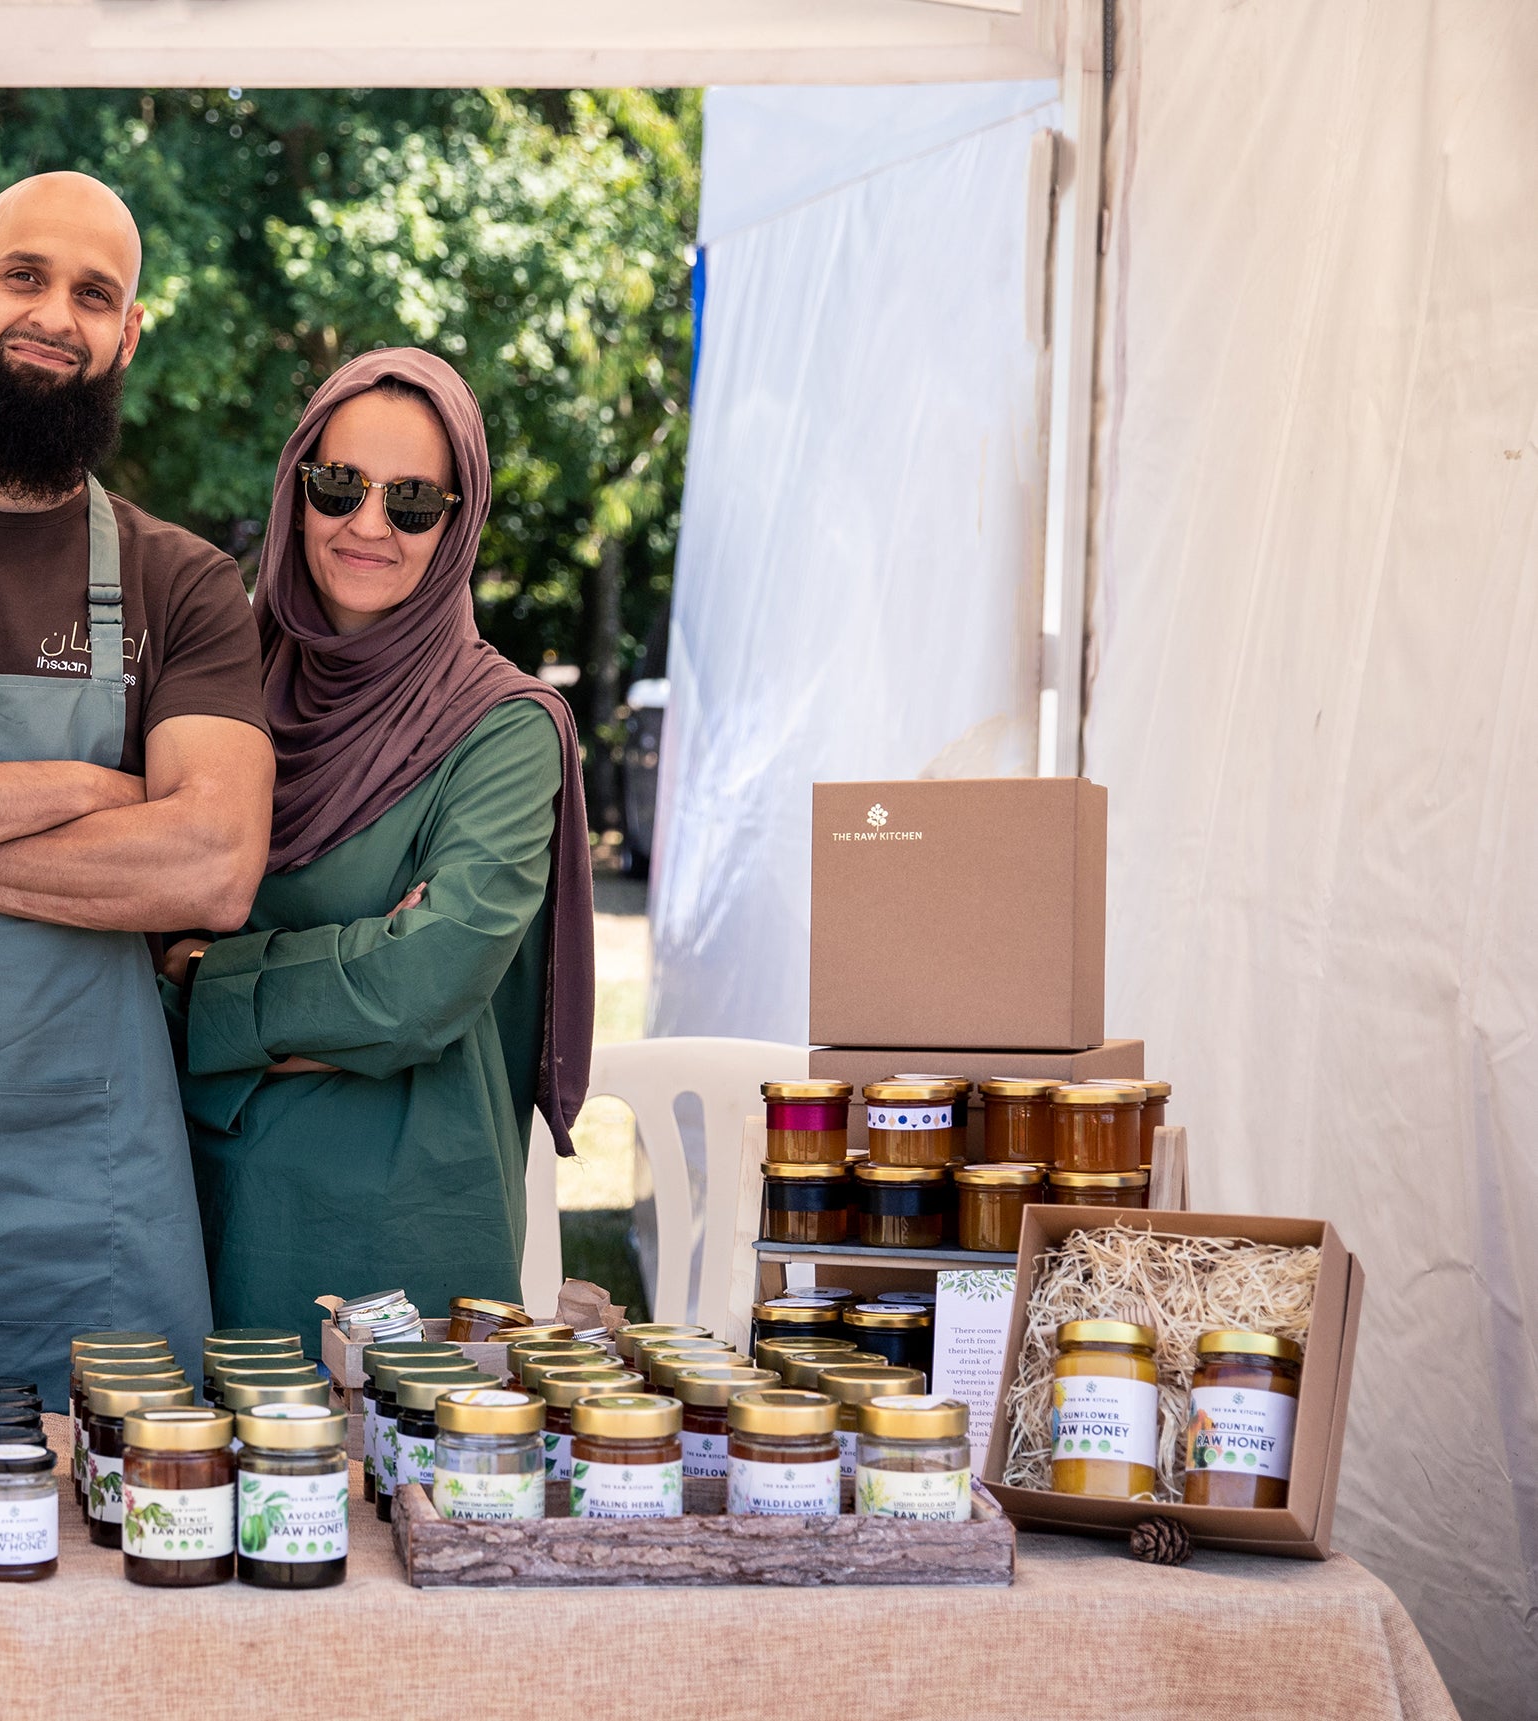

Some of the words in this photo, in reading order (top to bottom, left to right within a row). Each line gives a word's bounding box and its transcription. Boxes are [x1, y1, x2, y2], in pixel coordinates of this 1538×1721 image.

[36, 656, 88, 674] Ihsaan
[832, 832, 852, 842] THE
[854, 832, 878, 842] RAW
[879, 831, 923, 841] KITCHEN
[969, 1347, 997, 1356] bellies,
[946, 1369, 977, 1377] varying
[953, 1378, 987, 1386] wherein
[952, 1388, 982, 1397] healing
[983, 1388, 995, 1396] for
[1063, 1411, 1120, 1420] SUNFLOWER
[1057, 1424, 1079, 1436] RAW
[1081, 1424, 1130, 1438] HONEY
[1211, 1421, 1265, 1433] MOUNTAIN
[1196, 1434, 1223, 1447] RAW
[1226, 1436, 1277, 1452] HONEY
[589, 1498, 628, 1509] HEALING
[631, 1501, 665, 1509] HERBAL
[752, 1498, 824, 1508] WILDFLOWER
[288, 1510, 337, 1520] AVOCADO
[892, 1510, 918, 1520] RAW
[922, 1510, 956, 1521] HONEY
[152, 1526, 175, 1536] RAW
[179, 1526, 214, 1536] HONEY
[273, 1524, 304, 1537] RAW
[308, 1521, 343, 1537] HONEY
[10, 1539, 48, 1551] HONEY
